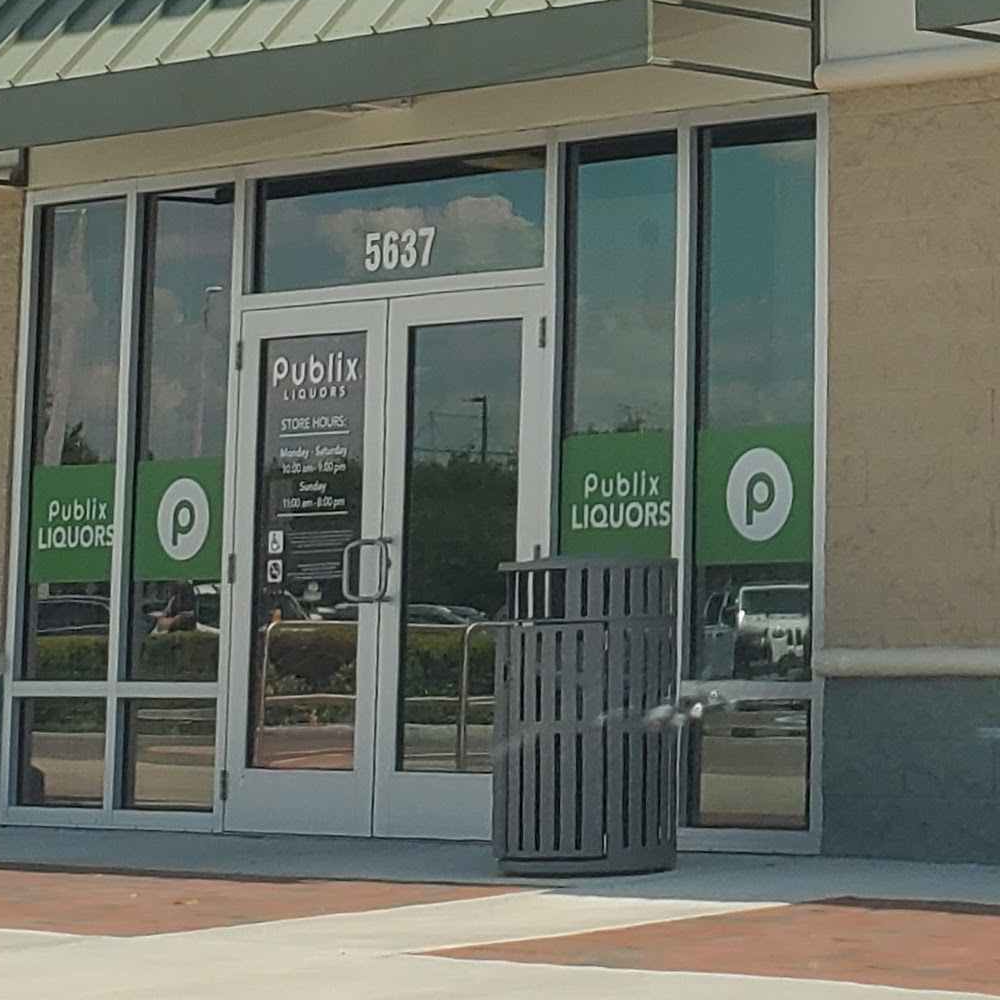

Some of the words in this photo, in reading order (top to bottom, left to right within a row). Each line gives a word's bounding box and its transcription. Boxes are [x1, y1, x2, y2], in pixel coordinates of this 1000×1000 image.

[365, 226, 436, 271] 5637
[272, 351, 359, 387] Publix
[283, 385, 347, 400] LIQUORS
[281, 417, 310, 431] STORE
[280, 447, 309, 459] Monday
[315, 445, 347, 458] Saturday
[333, 463, 346, 474] pm
[299, 480, 327, 493] Sunday
[584, 470, 660, 498] Publix
[48, 498, 107, 523] Publix
[333, 498, 345, 508] pm
[572, 501, 671, 530] LIQUORS
[38, 524, 115, 550] LIQUORS
